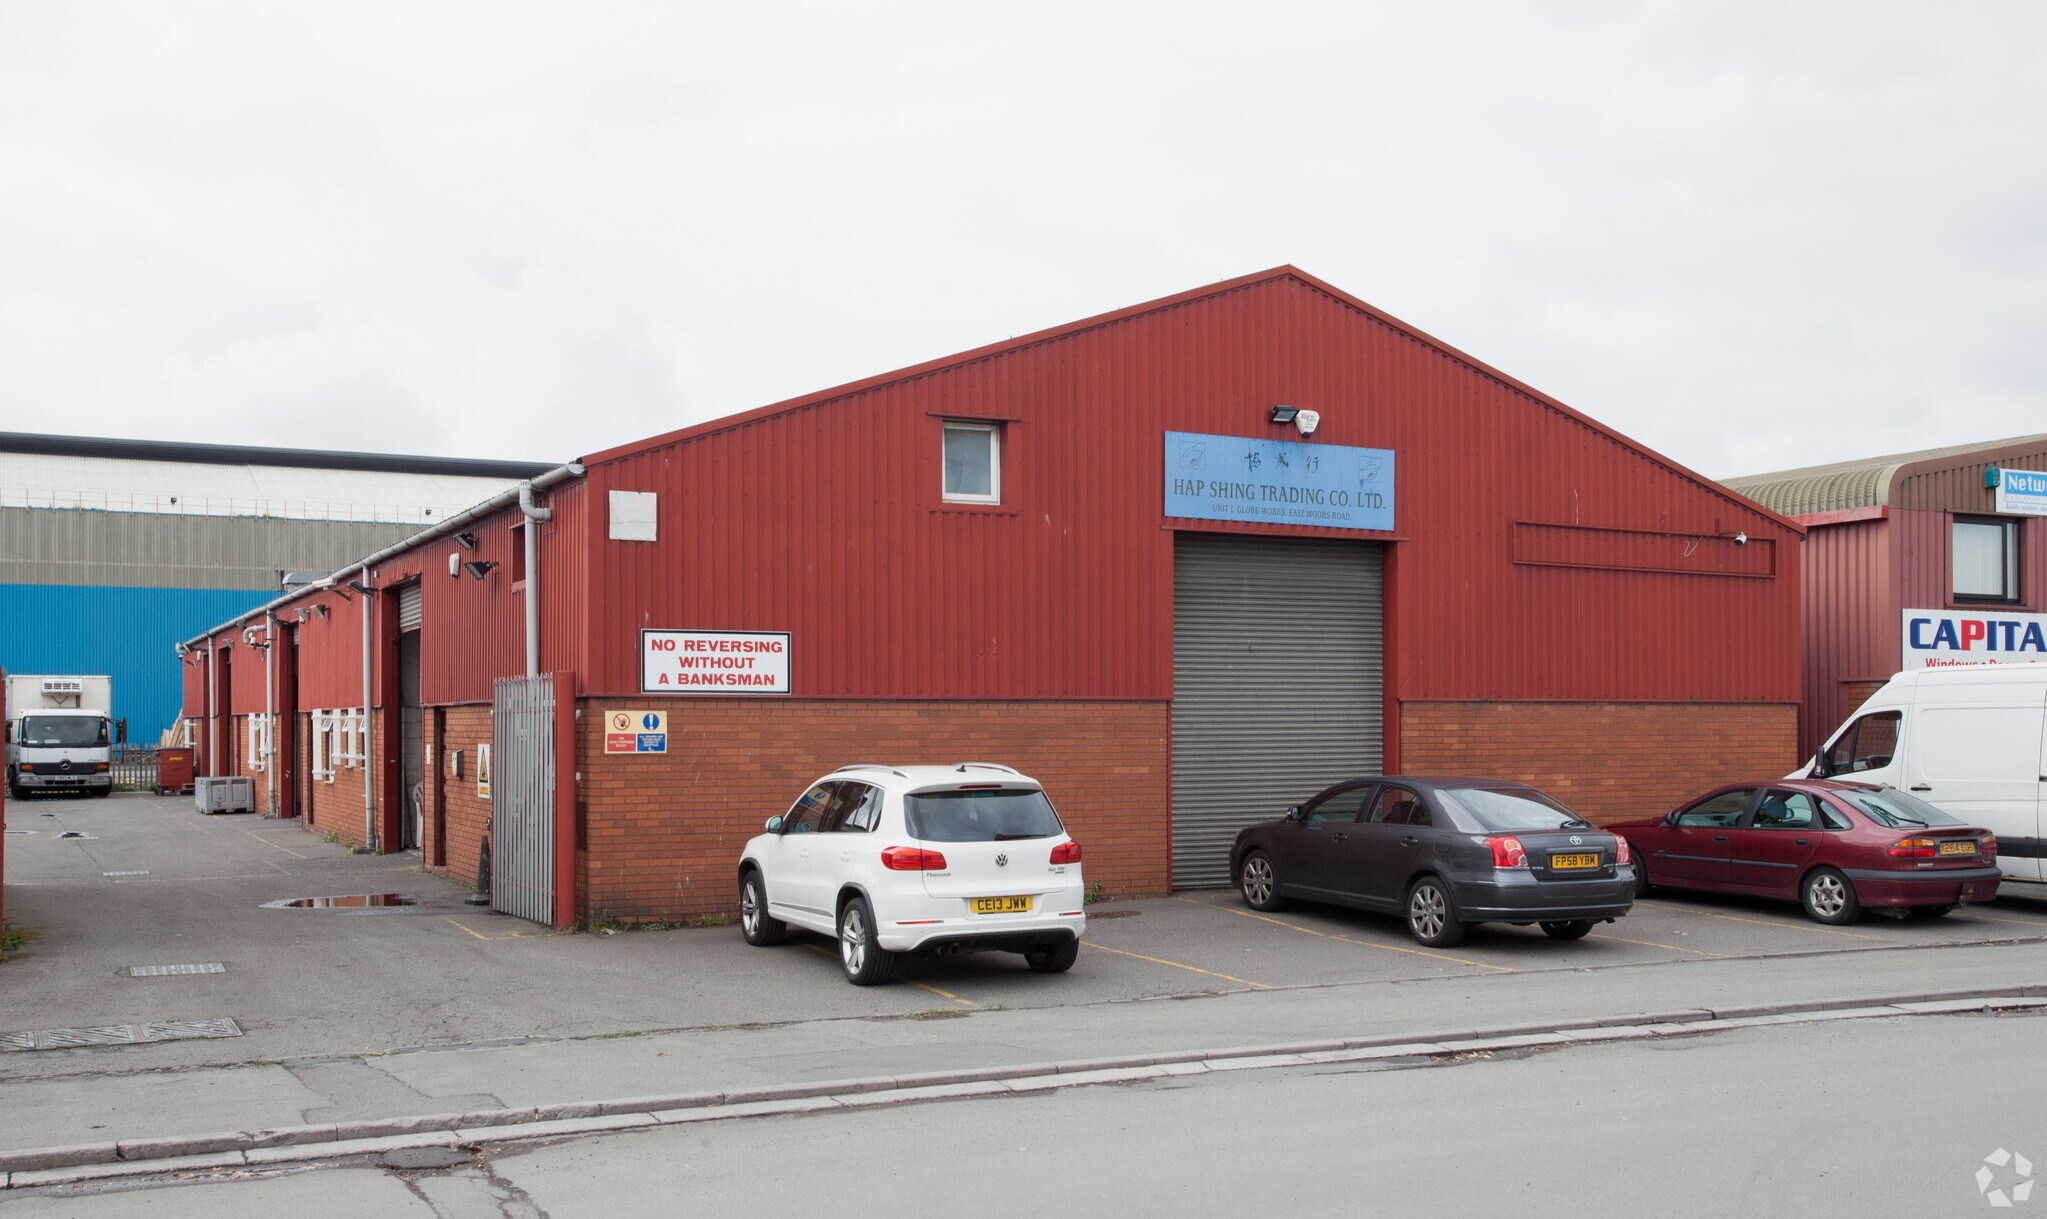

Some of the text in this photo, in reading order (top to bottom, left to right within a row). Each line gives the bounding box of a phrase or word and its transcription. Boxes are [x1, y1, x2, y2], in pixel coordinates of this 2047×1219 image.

[2008, 474, 2047, 493] Netw
[1173, 479, 1386, 510] HAP SHING TRADING CO. LTD.
[1212, 504, 1229, 513] UNIT
[1236, 505, 1259, 515] GLOBE
[1288, 509, 1305, 518] EAST
[1306, 511, 1331, 520] MOORS
[1909, 618, 2047, 653] CAPITA
[651, 639, 783, 653] NO REVERSING
[679, 656, 756, 669] WITHOUT
[658, 673, 775, 686] A BANKSMAN
[1555, 856, 1578, 866] FP58
[977, 897, 1027, 911] CE13 JWW
